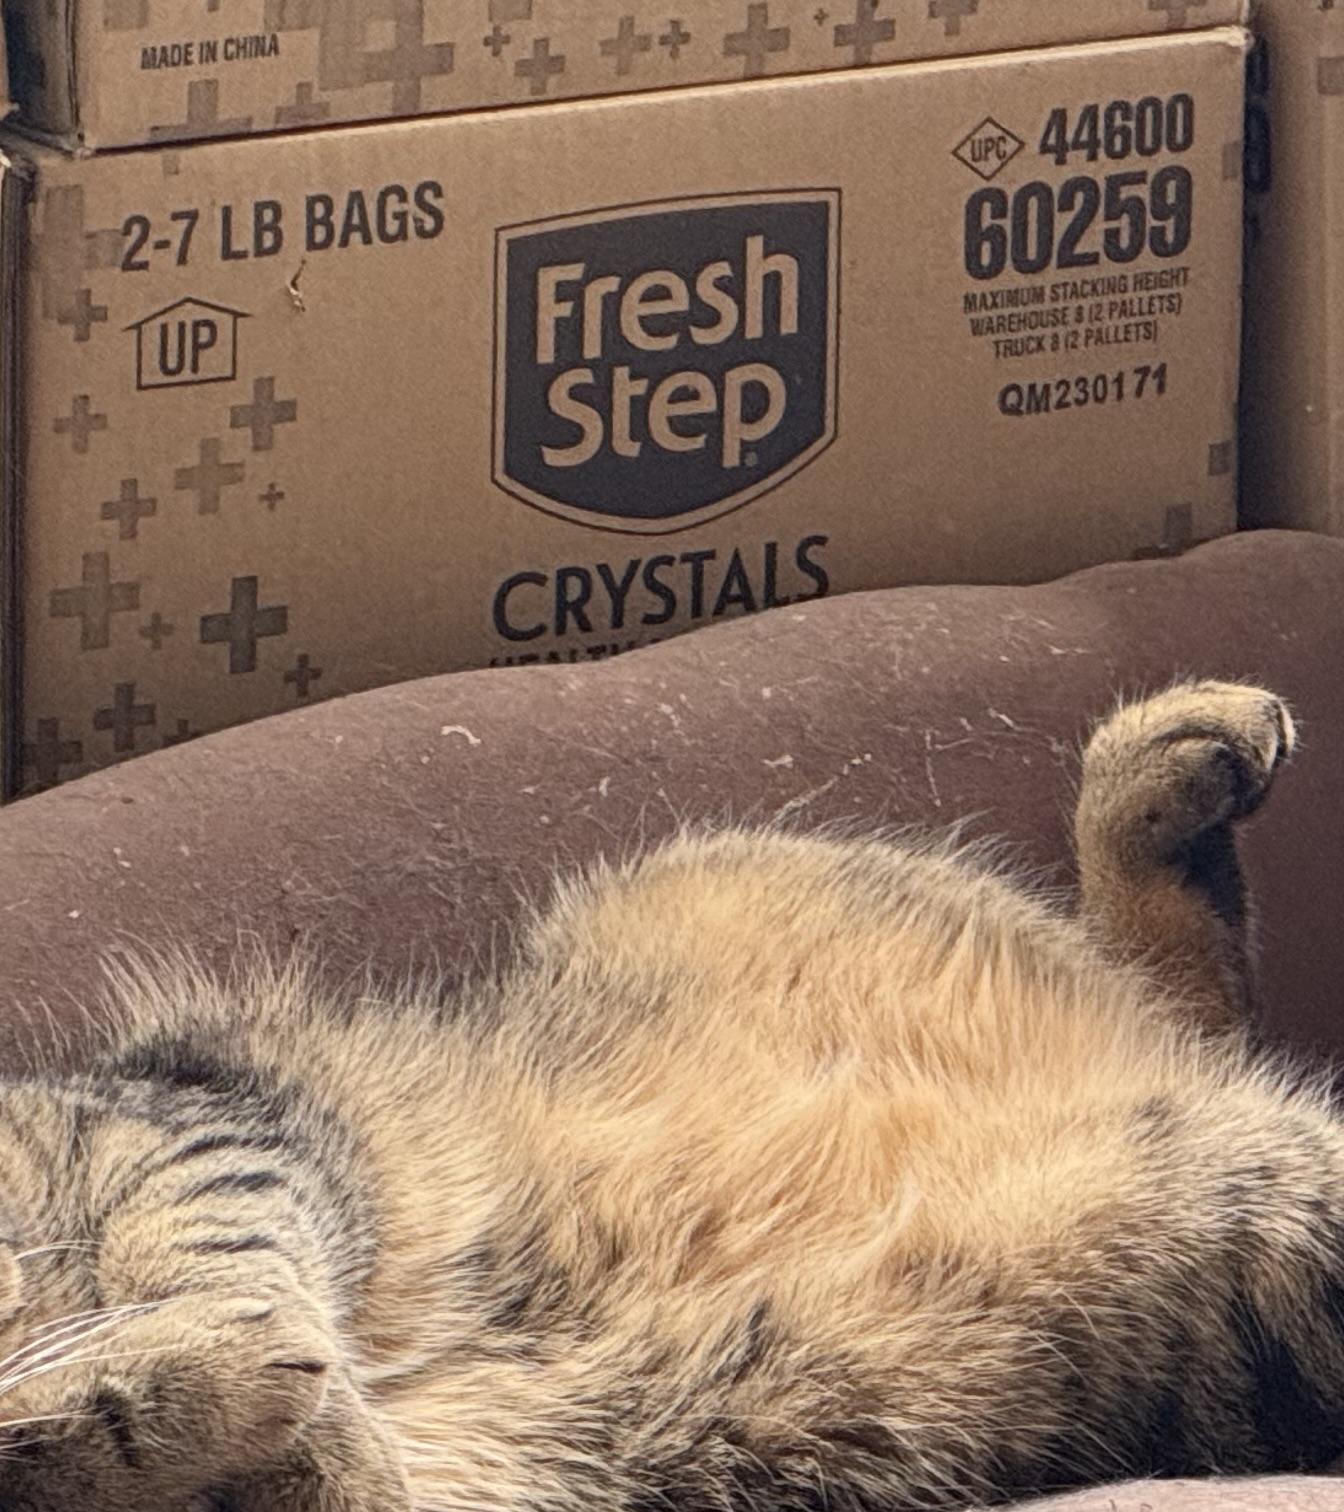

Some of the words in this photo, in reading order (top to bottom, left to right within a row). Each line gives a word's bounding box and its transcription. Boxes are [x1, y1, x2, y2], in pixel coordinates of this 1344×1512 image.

[141, 45, 193, 69] MADE
[199, 41, 217, 63] IN
[223, 33, 279, 61] CHINA
[970, 137, 1007, 164] UPC
[1039, 93, 1194, 165] 44600
[121, 209, 199, 271] 2-7
[221, 199, 284, 260] LB
[305, 180, 445, 252] BAGS
[963, 165, 1193, 280] 60259
[535, 235, 800, 364] Fresh
[963, 285, 1046, 314] MAXIMUM
[1050, 274, 1128, 302] STACKING
[1133, 267, 1190, 291] HEIGHT
[970, 307, 1069, 336] WAREHOUSE
[1109, 293, 1183, 318] PALLETS)
[158, 319, 218, 376] UP
[993, 336, 1048, 359] TRUCK
[1084, 320, 1158, 347] PALLETS)
[539, 360, 787, 468] Step
[998, 363, 1167, 417] QM230171
[492, 534, 828, 641] CRYSTALS
